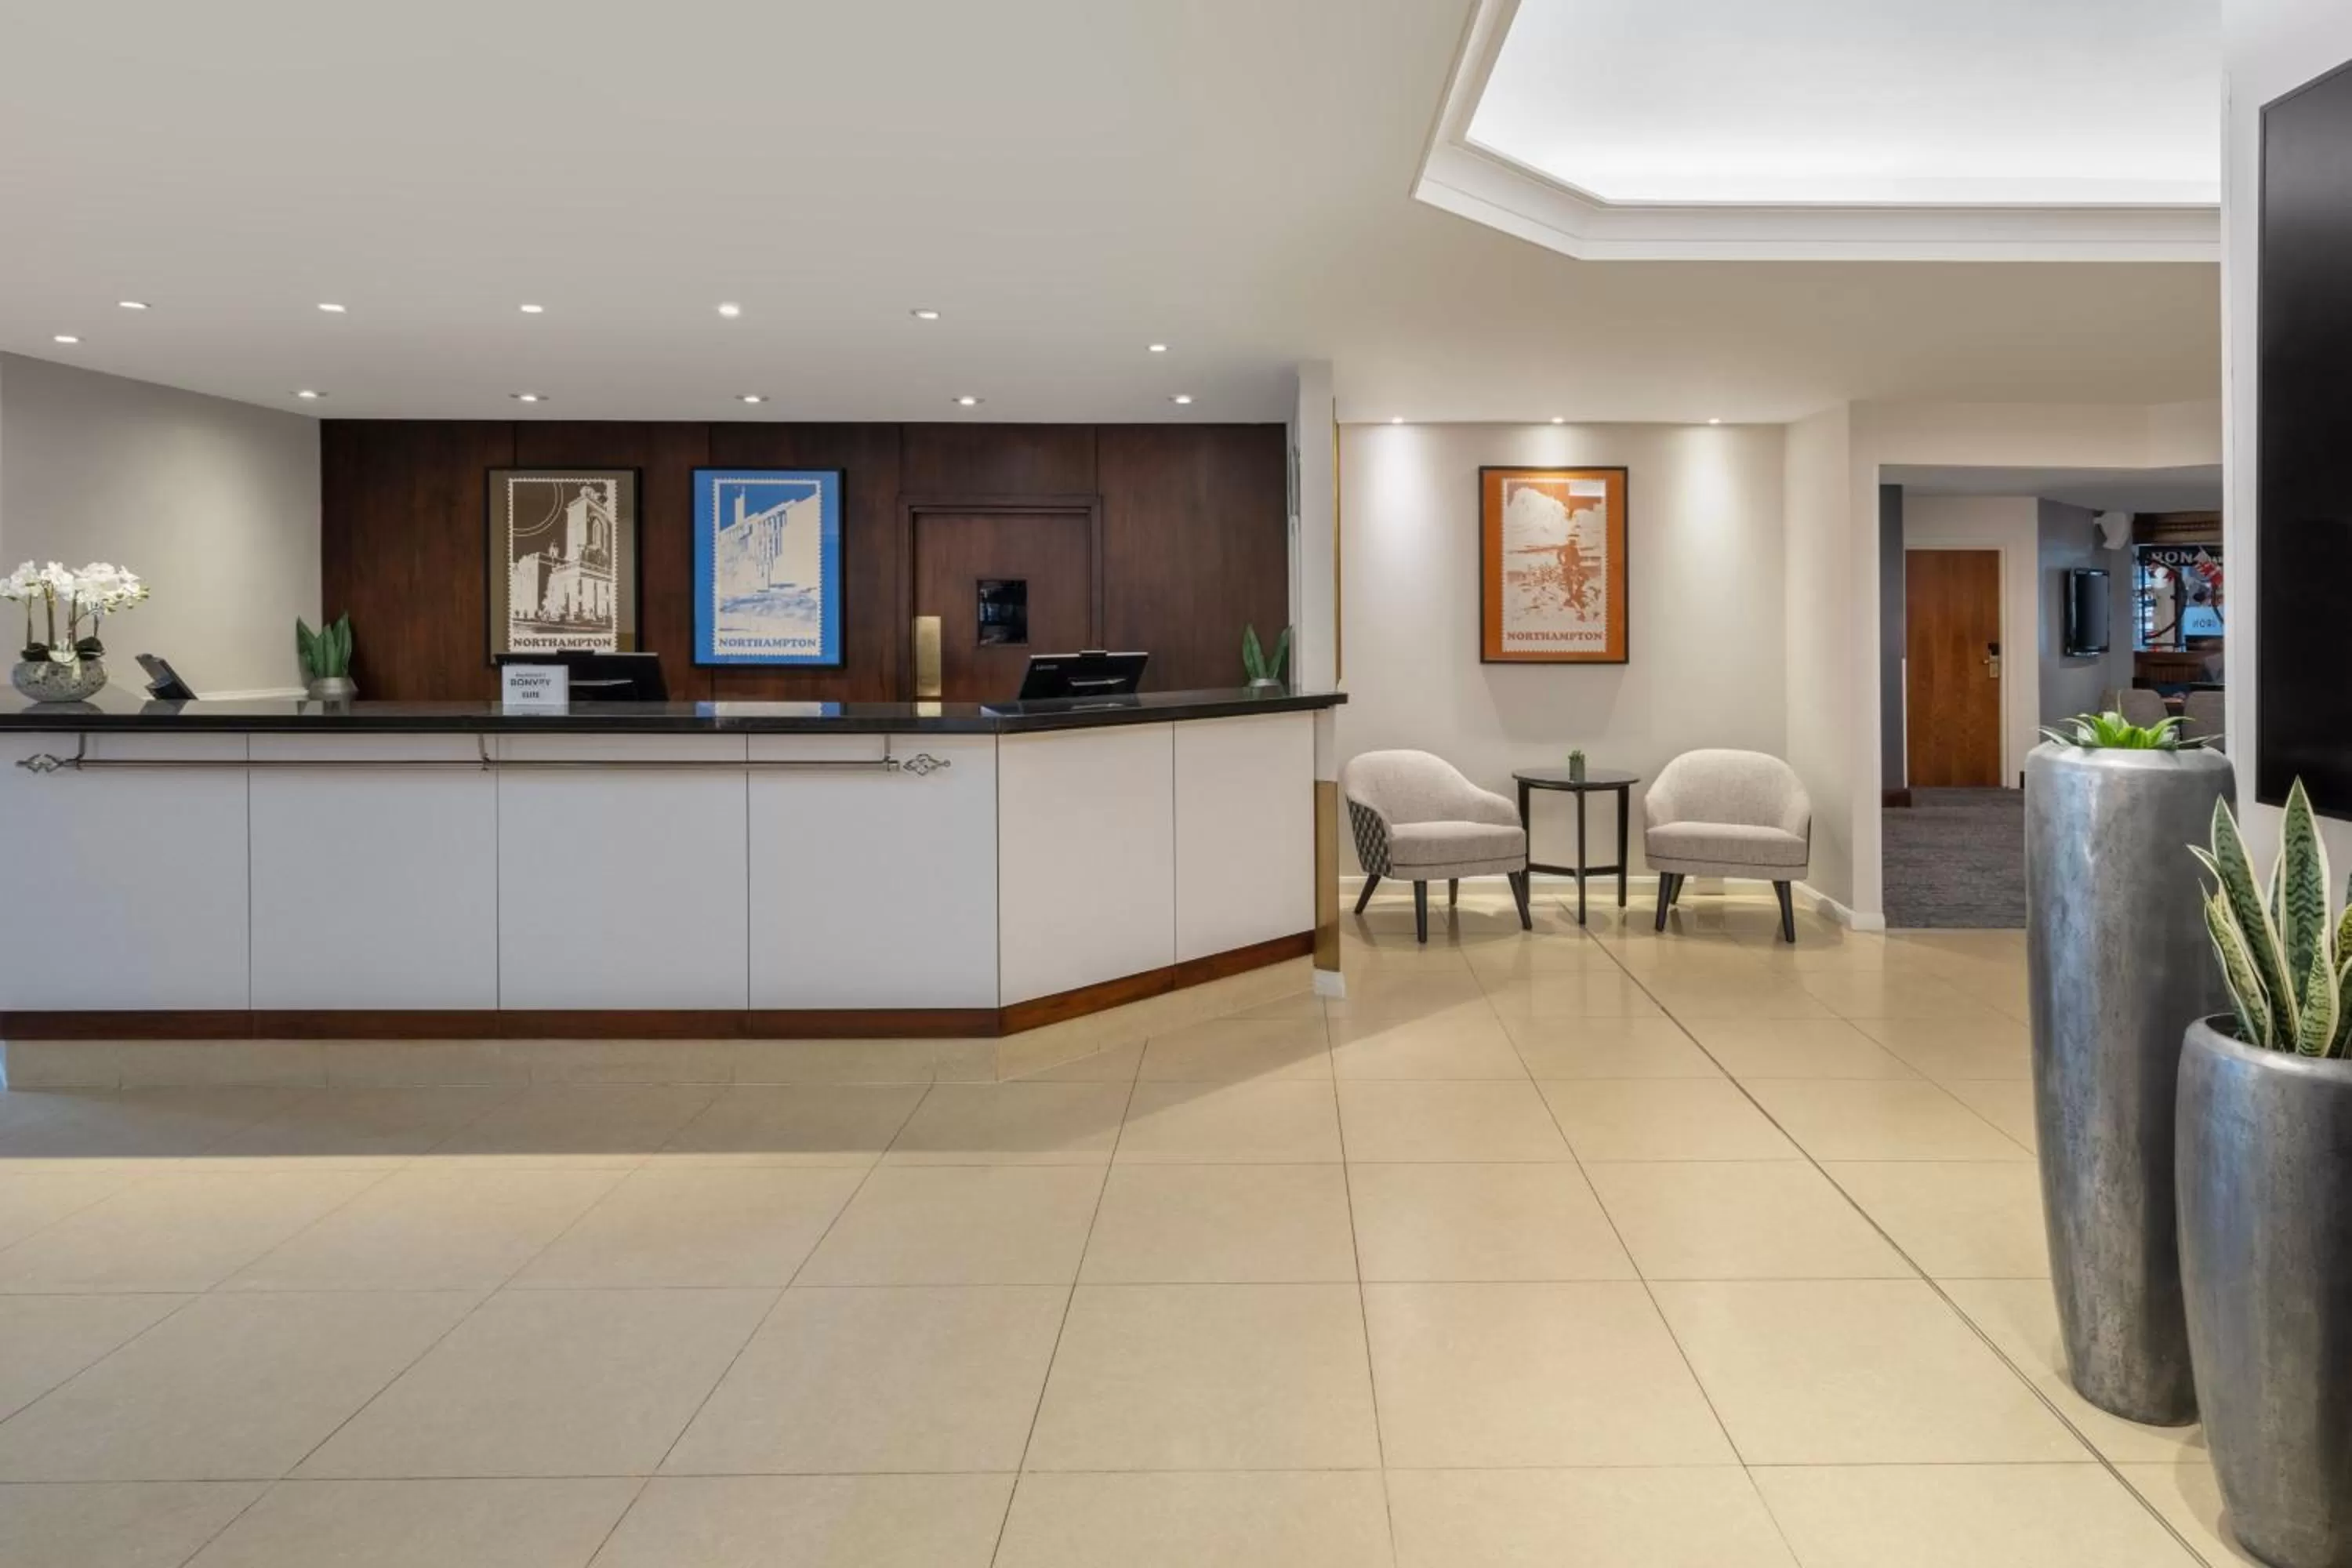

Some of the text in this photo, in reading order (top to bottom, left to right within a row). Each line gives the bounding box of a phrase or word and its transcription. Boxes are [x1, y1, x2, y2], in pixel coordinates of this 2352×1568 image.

[1507, 631, 1602, 641] NORTHAMPTON
[513, 637, 612, 647] NORTHAMPTON
[718, 637, 817, 647] NORTHAMPTON
